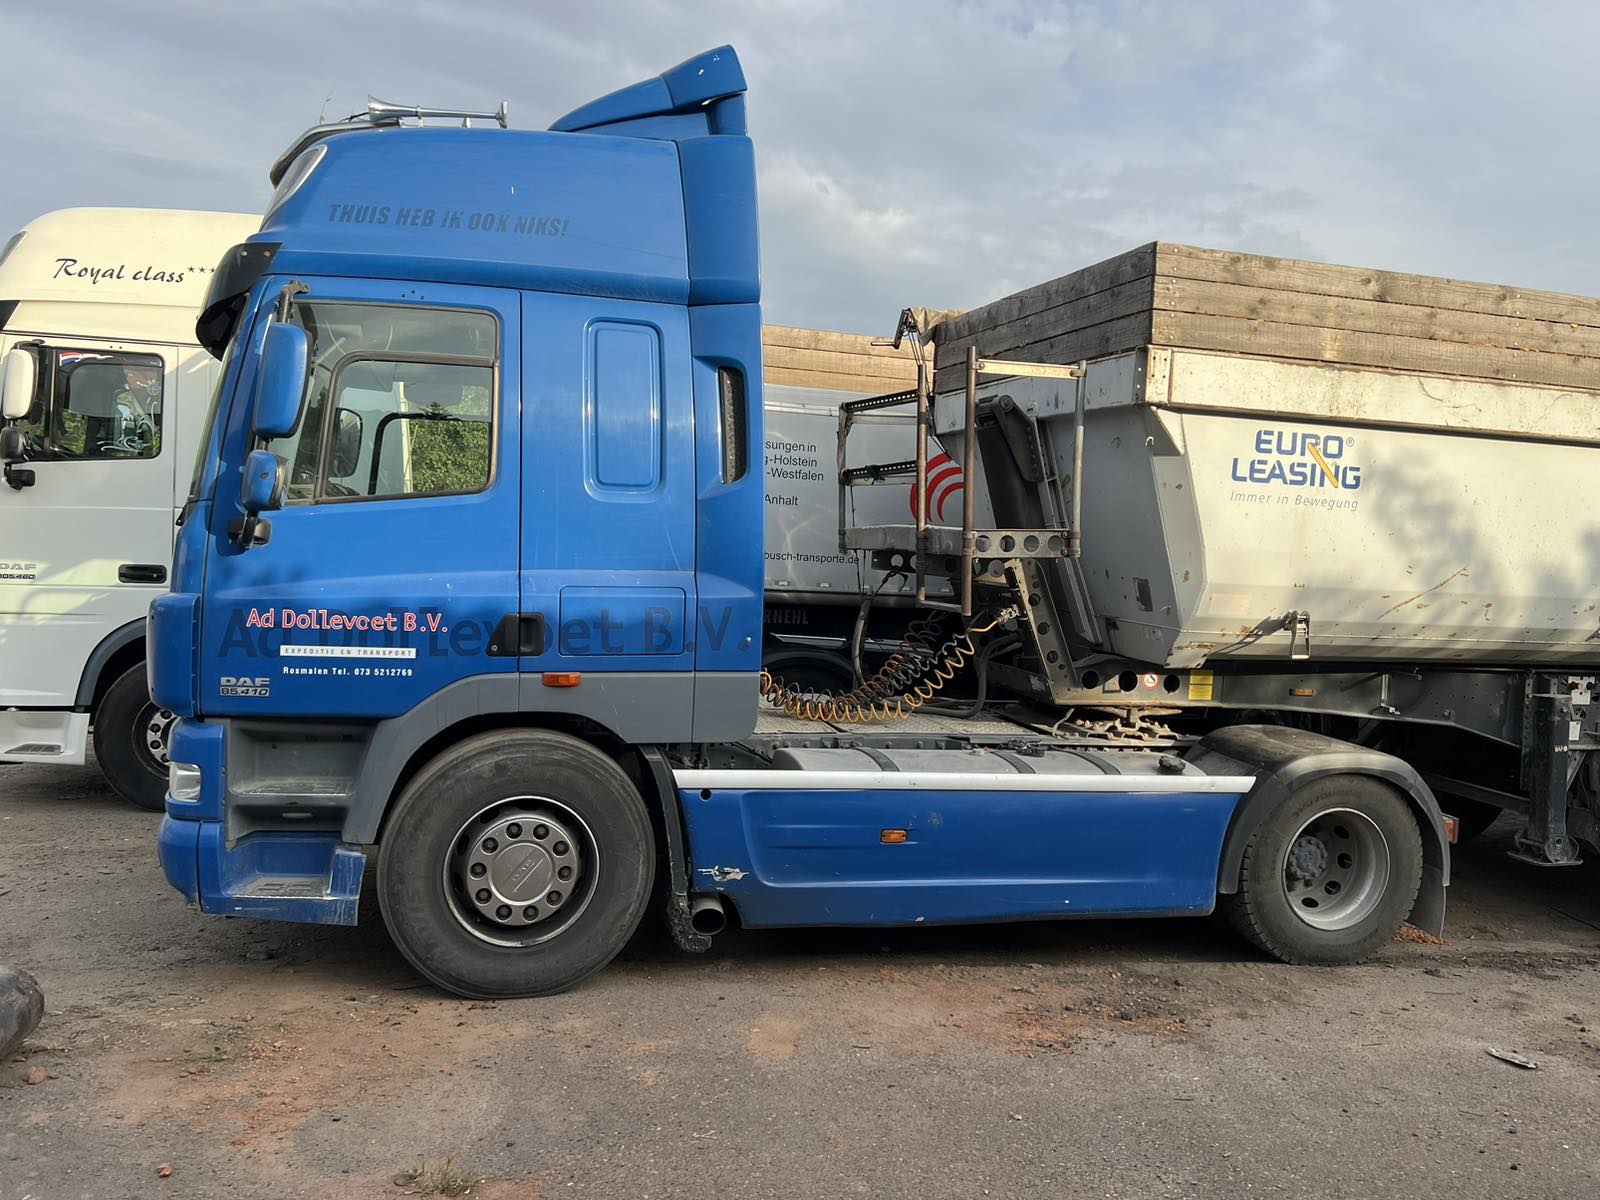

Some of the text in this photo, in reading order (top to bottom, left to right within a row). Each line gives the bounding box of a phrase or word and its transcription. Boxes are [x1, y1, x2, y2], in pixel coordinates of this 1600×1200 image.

[327, 203, 571, 237] THUIS HEB IK OOK NIKS!
[53, 258, 125, 284] Royal
[807, 442, 817, 453] in
[1231, 457, 1361, 490] LEASING
[1230, 490, 1359, 512] Immer in Bewegung
[246, 607, 275, 628] Ad
[403, 612, 448, 633] B.V.
[284, 647, 412, 657] EXPEDITIE EN TRANSPORT
[282, 666, 329, 676] Rosmalen
[332, 667, 350, 676] Tel.
[354, 667, 371, 677] 073
[220, 677, 272, 687] DAF
[220, 687, 269, 696] 85.410
